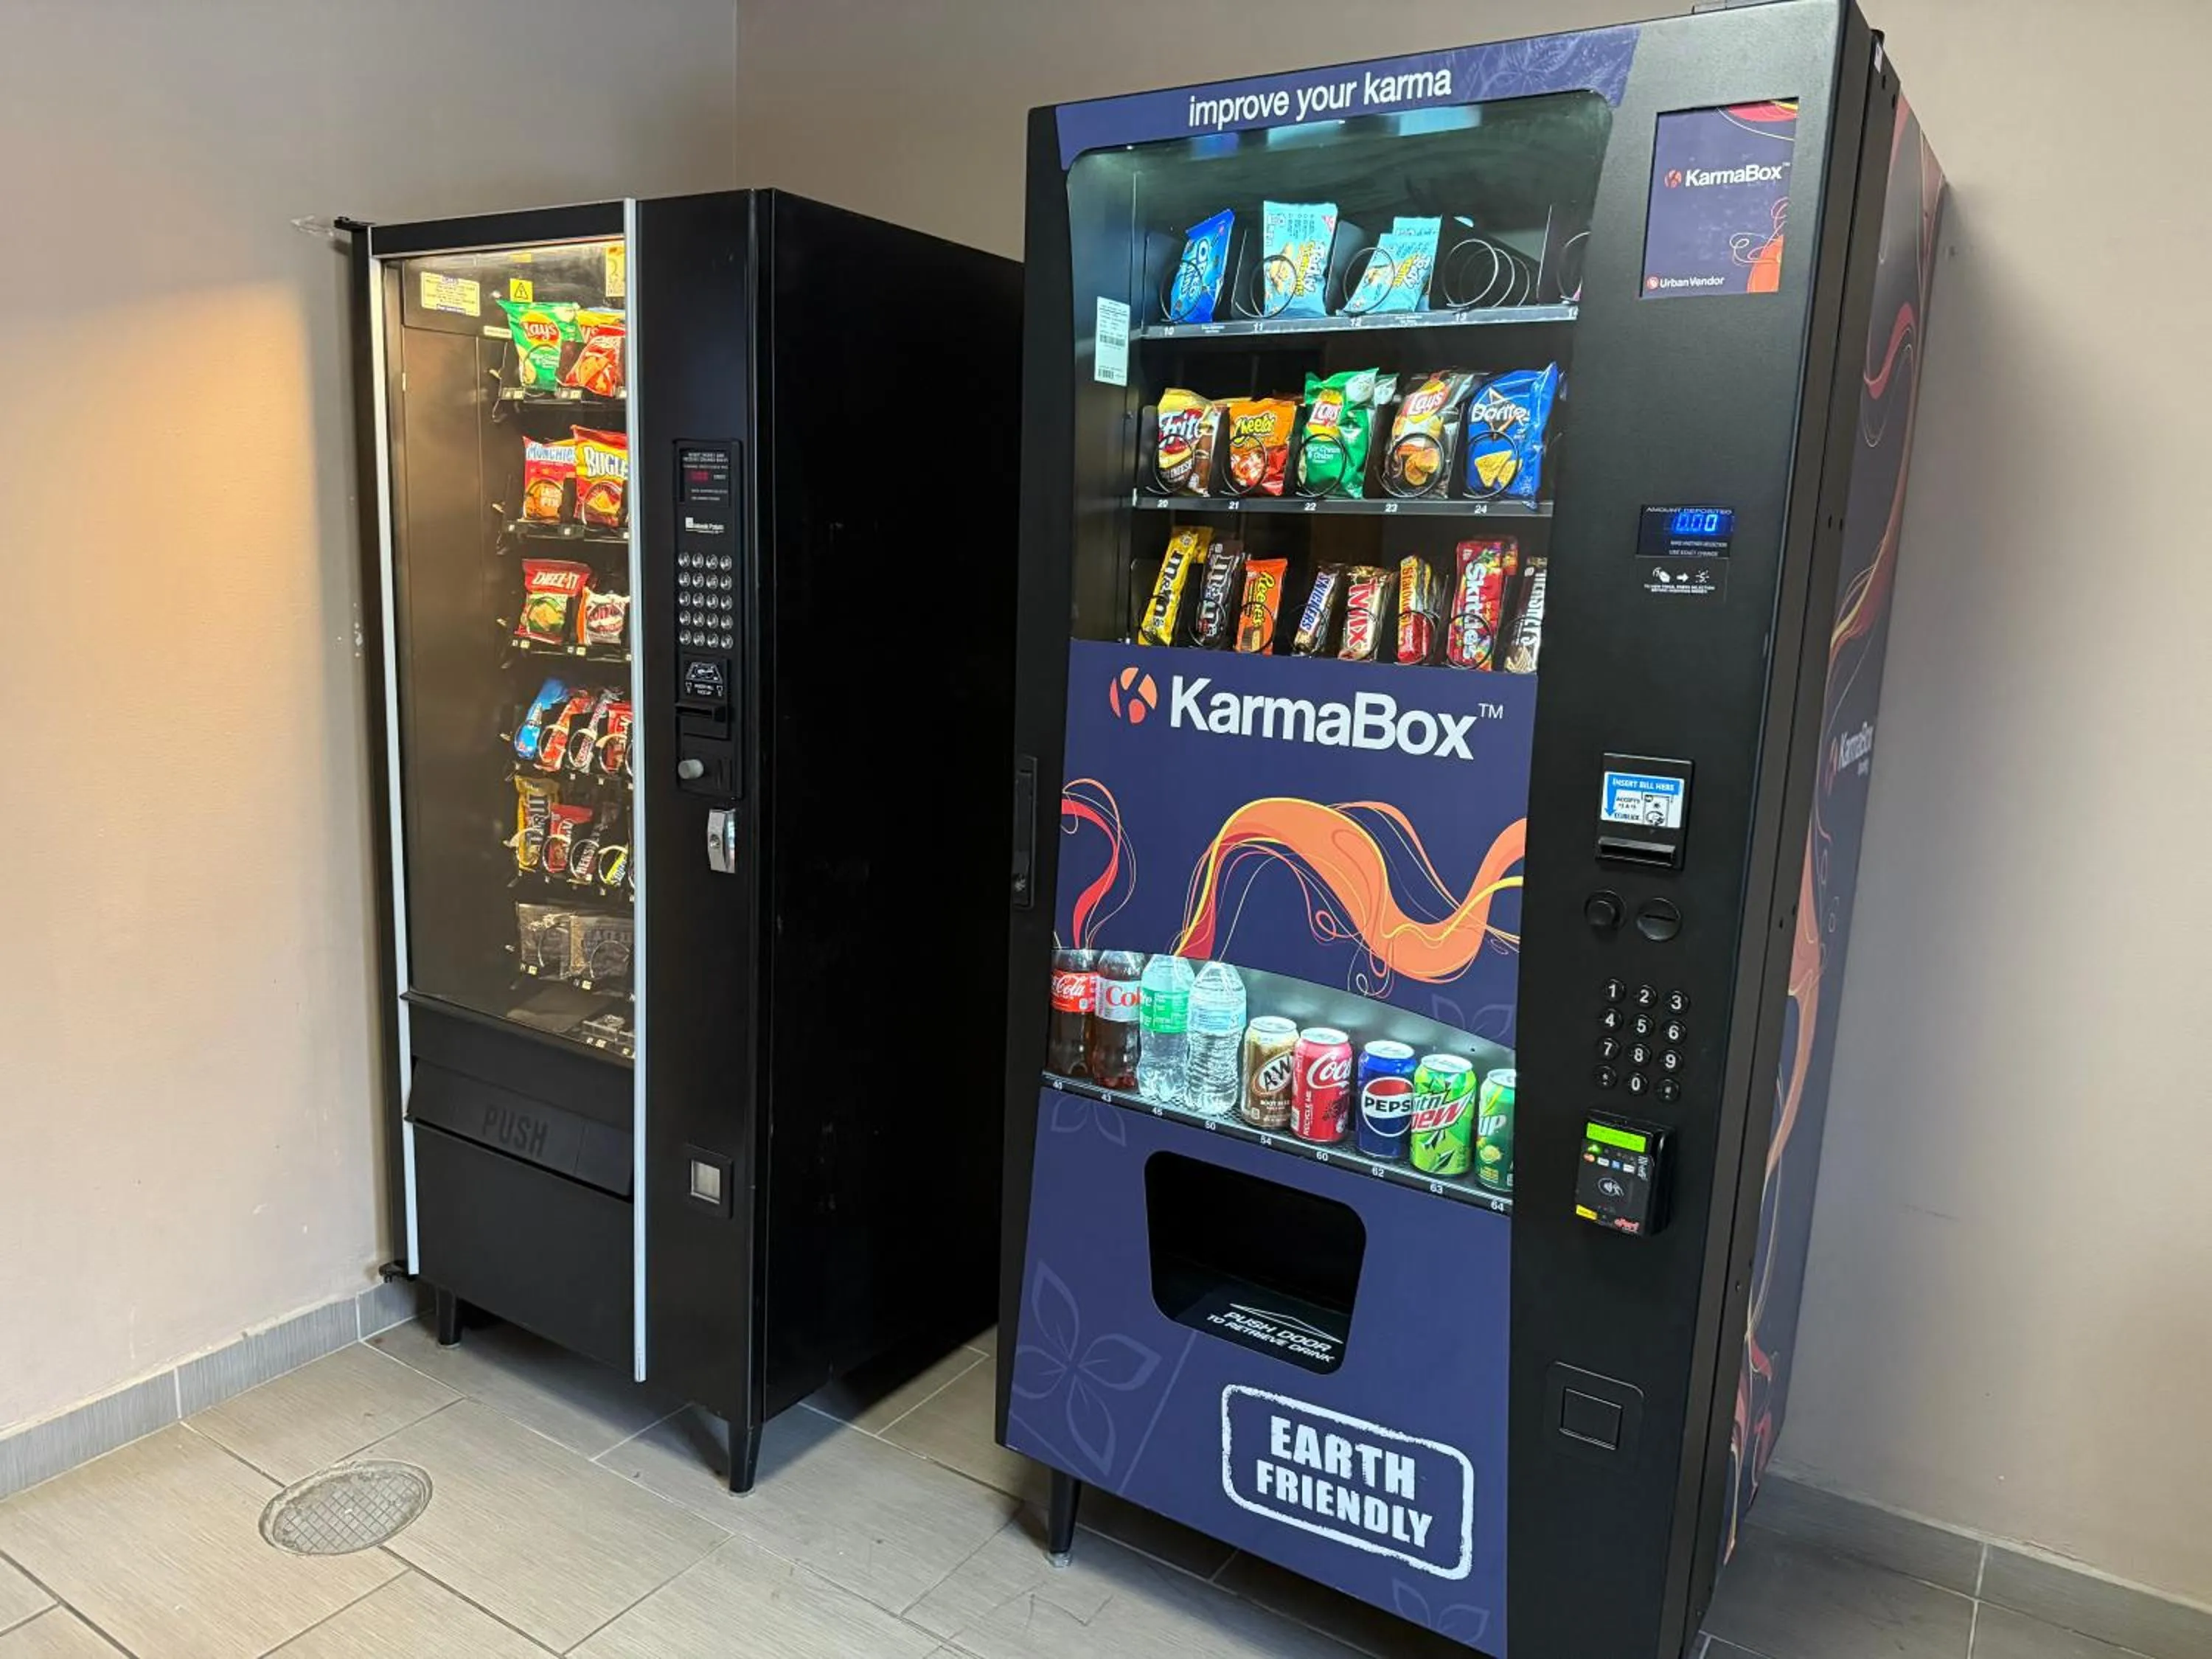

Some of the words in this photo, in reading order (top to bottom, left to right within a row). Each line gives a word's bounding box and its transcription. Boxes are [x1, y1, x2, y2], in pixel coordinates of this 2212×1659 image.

[1189, 91, 1290, 131] improve
[1295, 81, 1357, 122] your
[1363, 69, 1453, 105] karma
[1686, 164, 1782, 187] KarmaBox
[584, 445, 628, 479] BUGLE
[1158, 499, 1169, 507] 20
[1228, 501, 1239, 509] 21
[1305, 503, 1316, 511] 22
[1385, 504, 1398, 512] 23
[1475, 504, 1487, 514] 24
[1170, 674, 1478, 761] KarmaBox
[1105, 985, 1141, 1006] Co
[1608, 984, 1616, 998] 1
[1639, 989, 1649, 1004] 2
[1671, 995, 1682, 1009] 3
[1604, 1013, 1615, 1027] 4
[1636, 1019, 1646, 1033] 5
[1669, 1026, 1680, 1040] 6
[1604, 1041, 1613, 1056] 7
[1633, 1048, 1644, 1062] 8
[1665, 1054, 1676, 1068] 9
[1631, 1077, 1641, 1091] 0
[1365, 1096, 1411, 1113] PEPS
[481, 1107, 549, 1158] PUSH
[1316, 1152, 1328, 1162] 60
[1372, 1167, 1384, 1178] 62
[1430, 1183, 1443, 1194] 63
[1491, 1200, 1504, 1212] 64
[1206, 1314, 1225, 1324] TO
[1224, 1321, 1290, 1347] RETRIEVE
[1287, 1342, 1335, 1363] DRINK
[1222, 1311, 1278, 1333] PUSH
[1277, 1329, 1332, 1352] DOOR
[1270, 1415, 1415, 1500] EARTH
[1256, 1459, 1433, 1548] FRIENDLY
